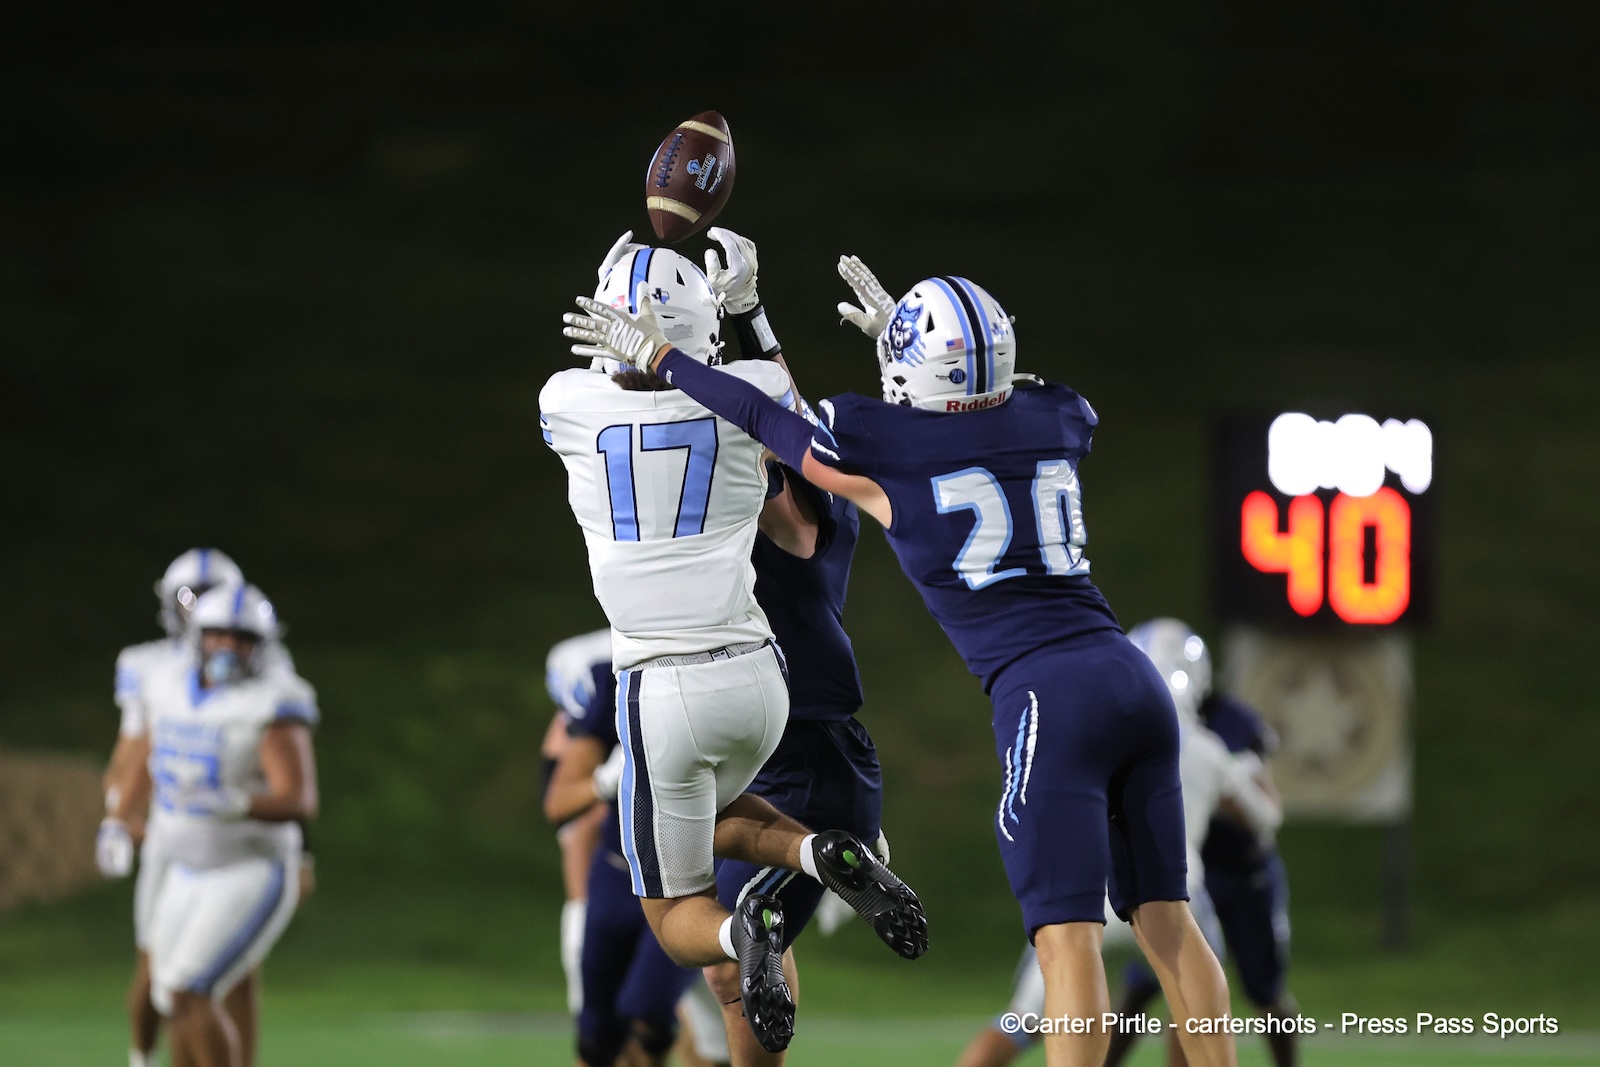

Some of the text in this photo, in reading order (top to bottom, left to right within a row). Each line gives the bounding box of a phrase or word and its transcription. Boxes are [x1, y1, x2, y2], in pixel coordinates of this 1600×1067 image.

[946, 391, 1007, 412] Riddell
[951, 369, 964, 382] 20
[597, 417, 718, 541] 17
[930, 459, 1091, 591] 20
[1241, 486, 1411, 624] 40
